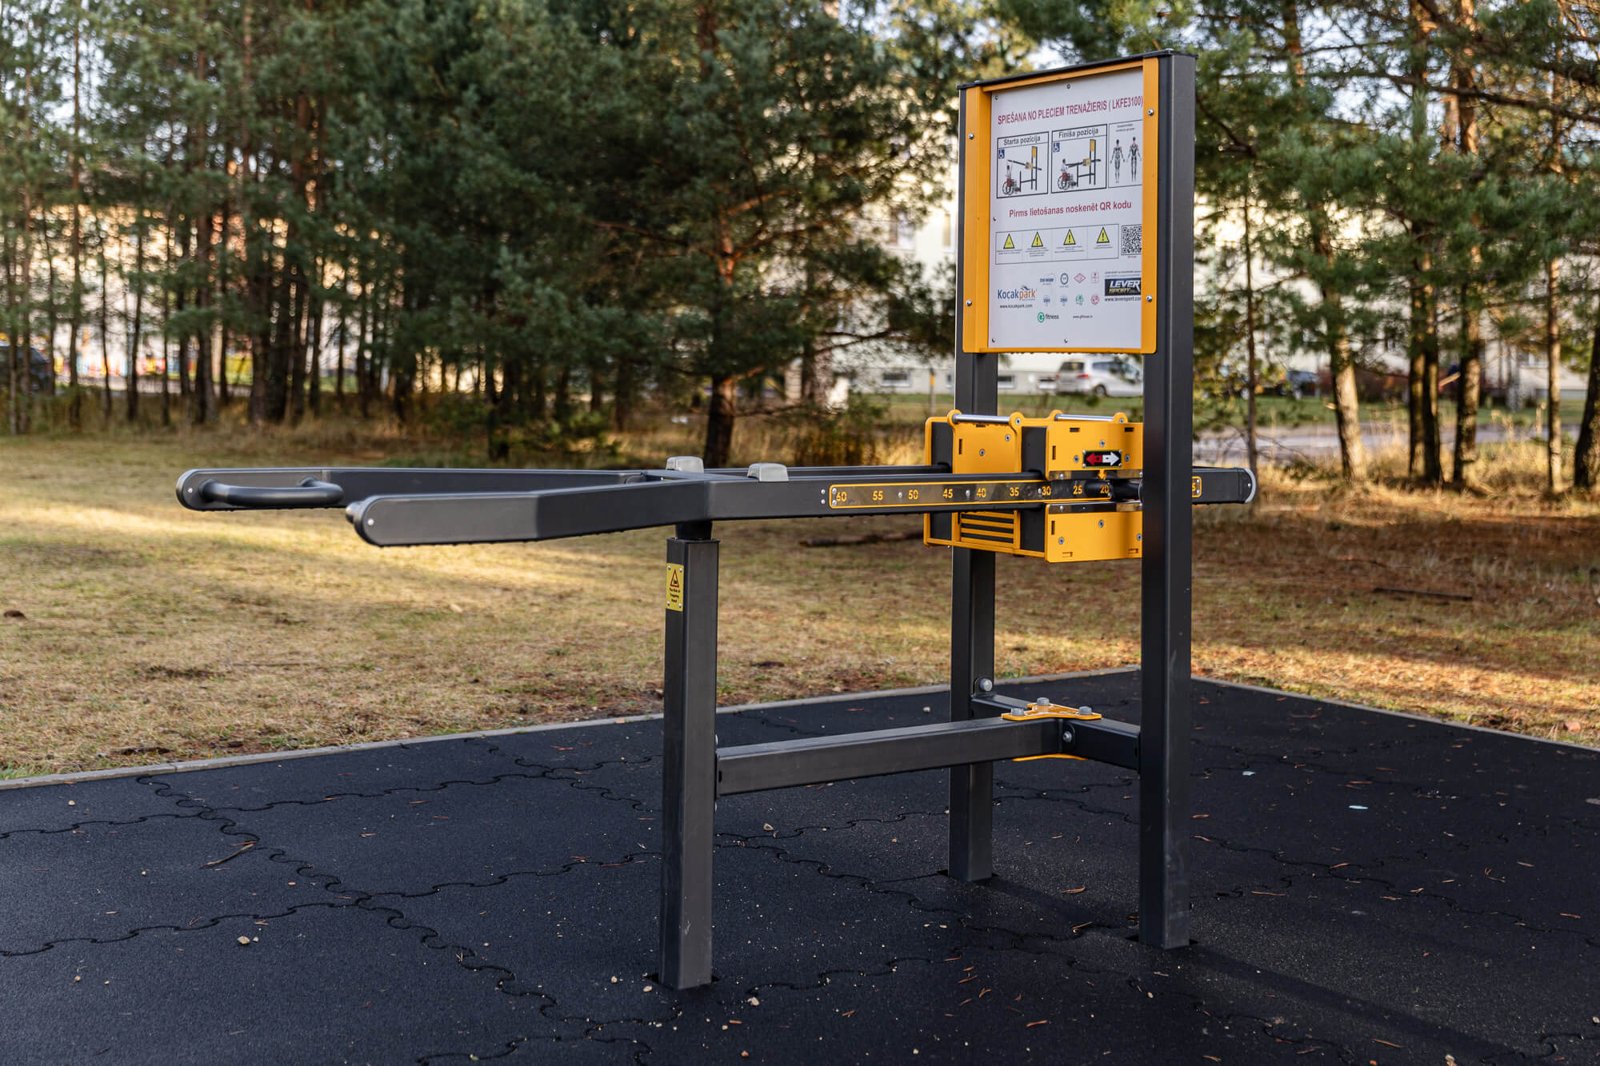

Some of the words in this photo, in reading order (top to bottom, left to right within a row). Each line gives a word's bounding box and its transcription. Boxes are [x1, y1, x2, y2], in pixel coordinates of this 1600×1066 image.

[997, 112, 1027, 125] SPIEŠANA
[1028, 110, 1037, 121] NO
[1038, 105, 1065, 119] PLECIEM
[1066, 100, 1107, 115] TRENAŽIERIS
[1009, 209, 1028, 218] Pirms
[1029, 206, 1064, 217] lietošanas
[1099, 201, 1111, 211] QR
[1113, 200, 1132, 209] kodu
[1109, 279, 1140, 292] LEVER
[836, 491, 848, 502] 60
[872, 490, 884, 501] 55
[908, 489, 919, 500] 50
[942, 488, 954, 499] 45
[976, 487, 987, 498] 40
[1009, 487, 1020, 497] 35
[1041, 486, 1052, 496] 30
[1072, 485, 1083, 495] 25
[1100, 484, 1110, 494] 20
